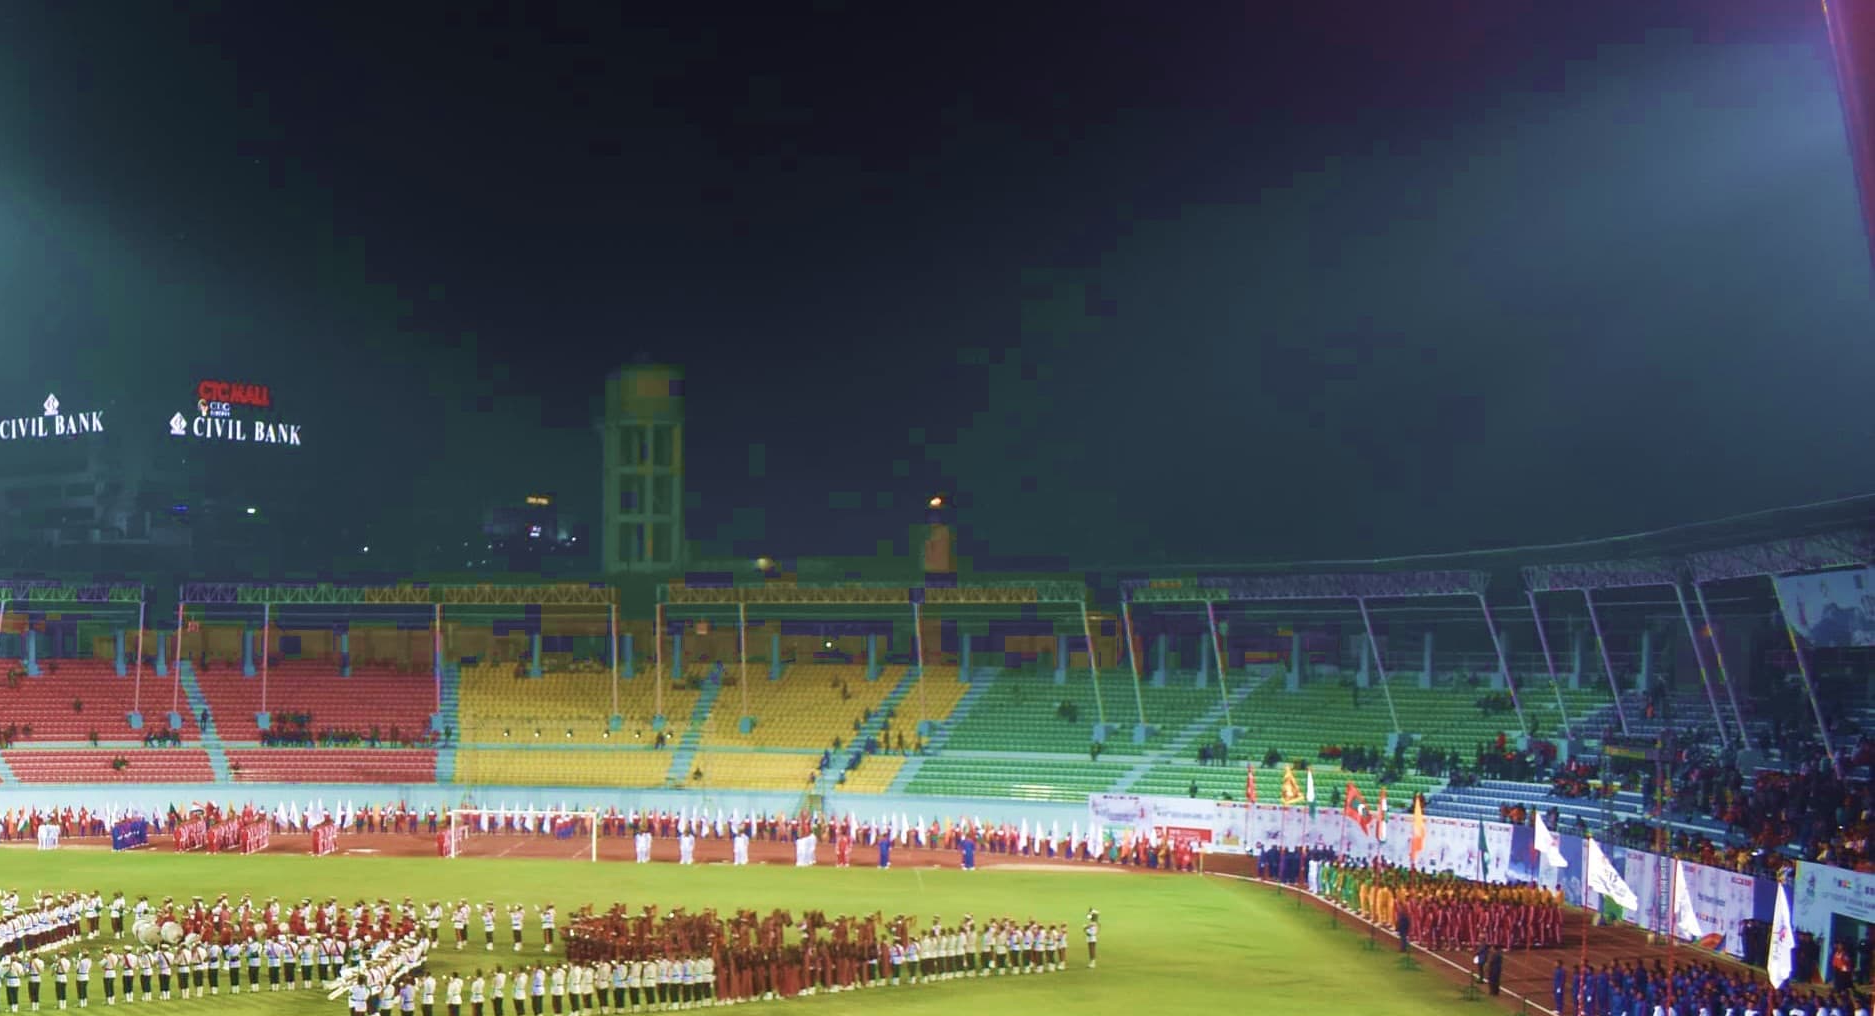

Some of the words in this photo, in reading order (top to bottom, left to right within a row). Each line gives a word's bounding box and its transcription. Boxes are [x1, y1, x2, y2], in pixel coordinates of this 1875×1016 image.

[199, 380, 230, 401] CTC
[230, 383, 270, 406] MALL
[0, 415, 48, 440] CIVIL
[55, 411, 104, 436] BANK
[193, 416, 246, 441] CIVIL
[254, 421, 302, 445] BANK
